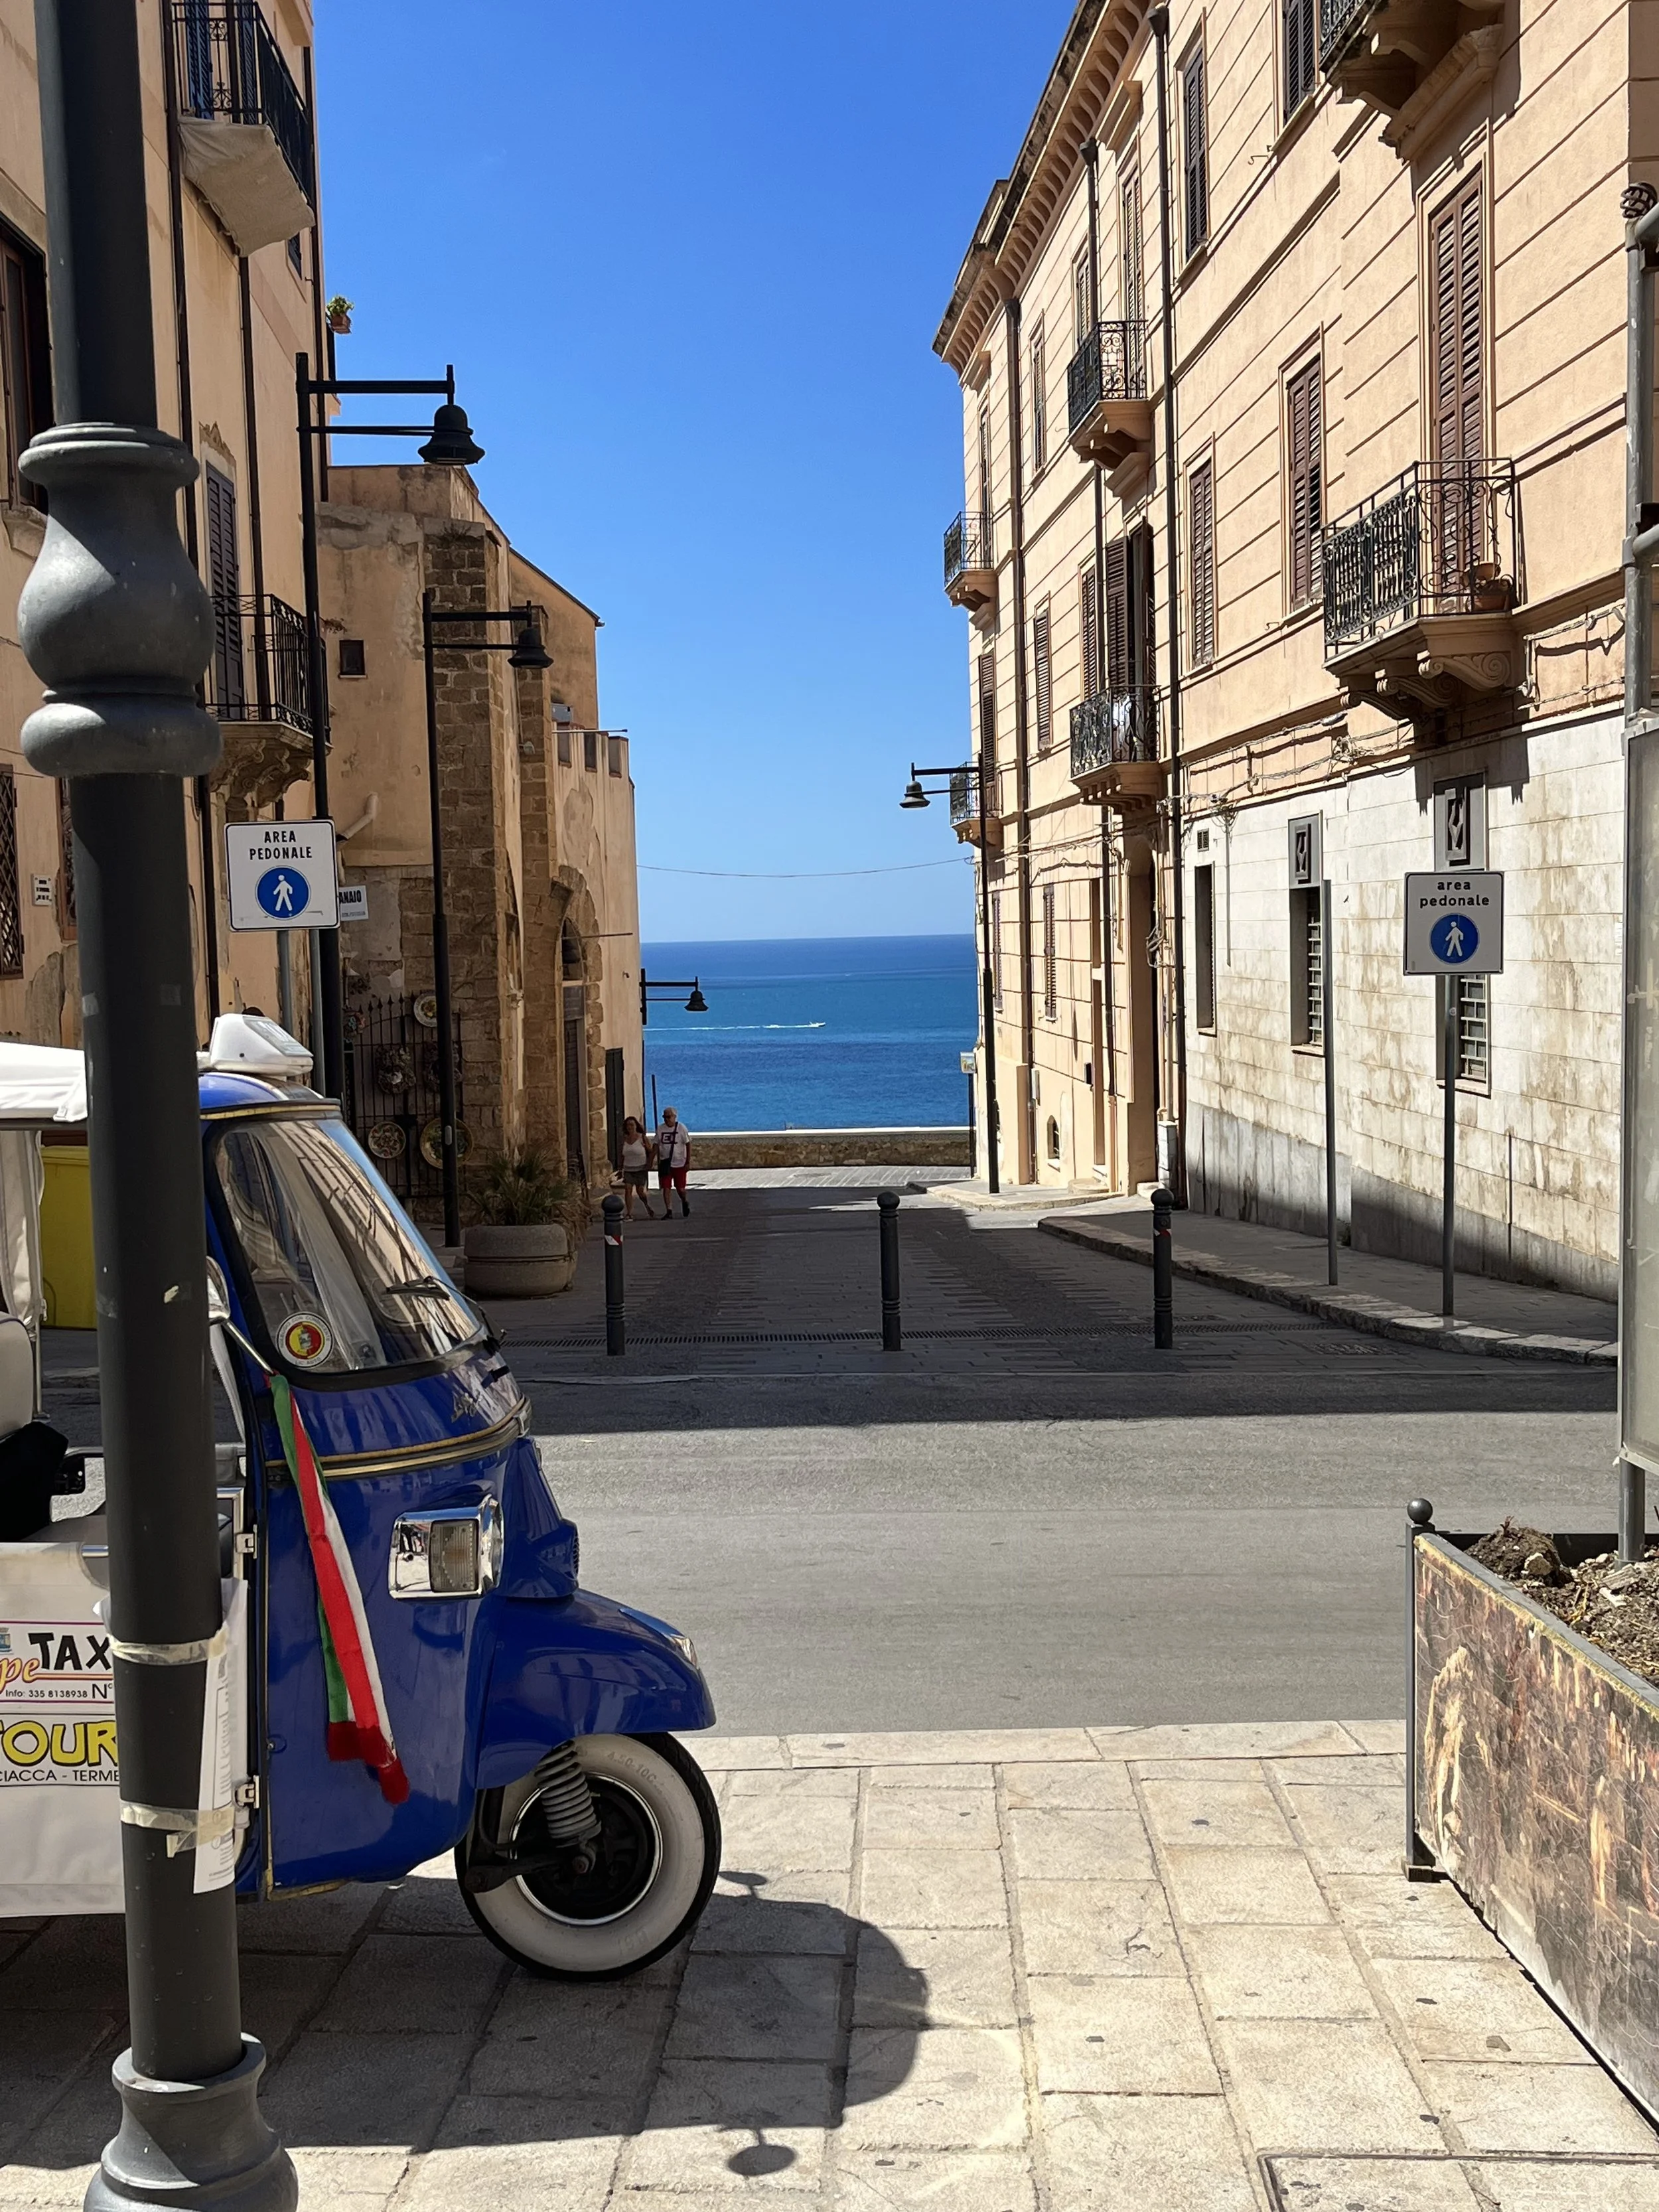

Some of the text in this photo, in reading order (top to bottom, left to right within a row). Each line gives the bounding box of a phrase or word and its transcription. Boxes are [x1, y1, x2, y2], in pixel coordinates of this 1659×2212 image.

[264, 830, 296, 844] AREA
[249, 847, 313, 860] PEDONALE
[1437, 881, 1471, 891] area
[1419, 894, 1490, 909] pedonale
[5, 1689, 26, 1698] Info:
[29, 1689, 45, 1698] 335
[48, 1690, 88, 1698] 8138938
[0, 1720, 117, 1767] OUR
[72, 1770, 119, 1782] TERME
